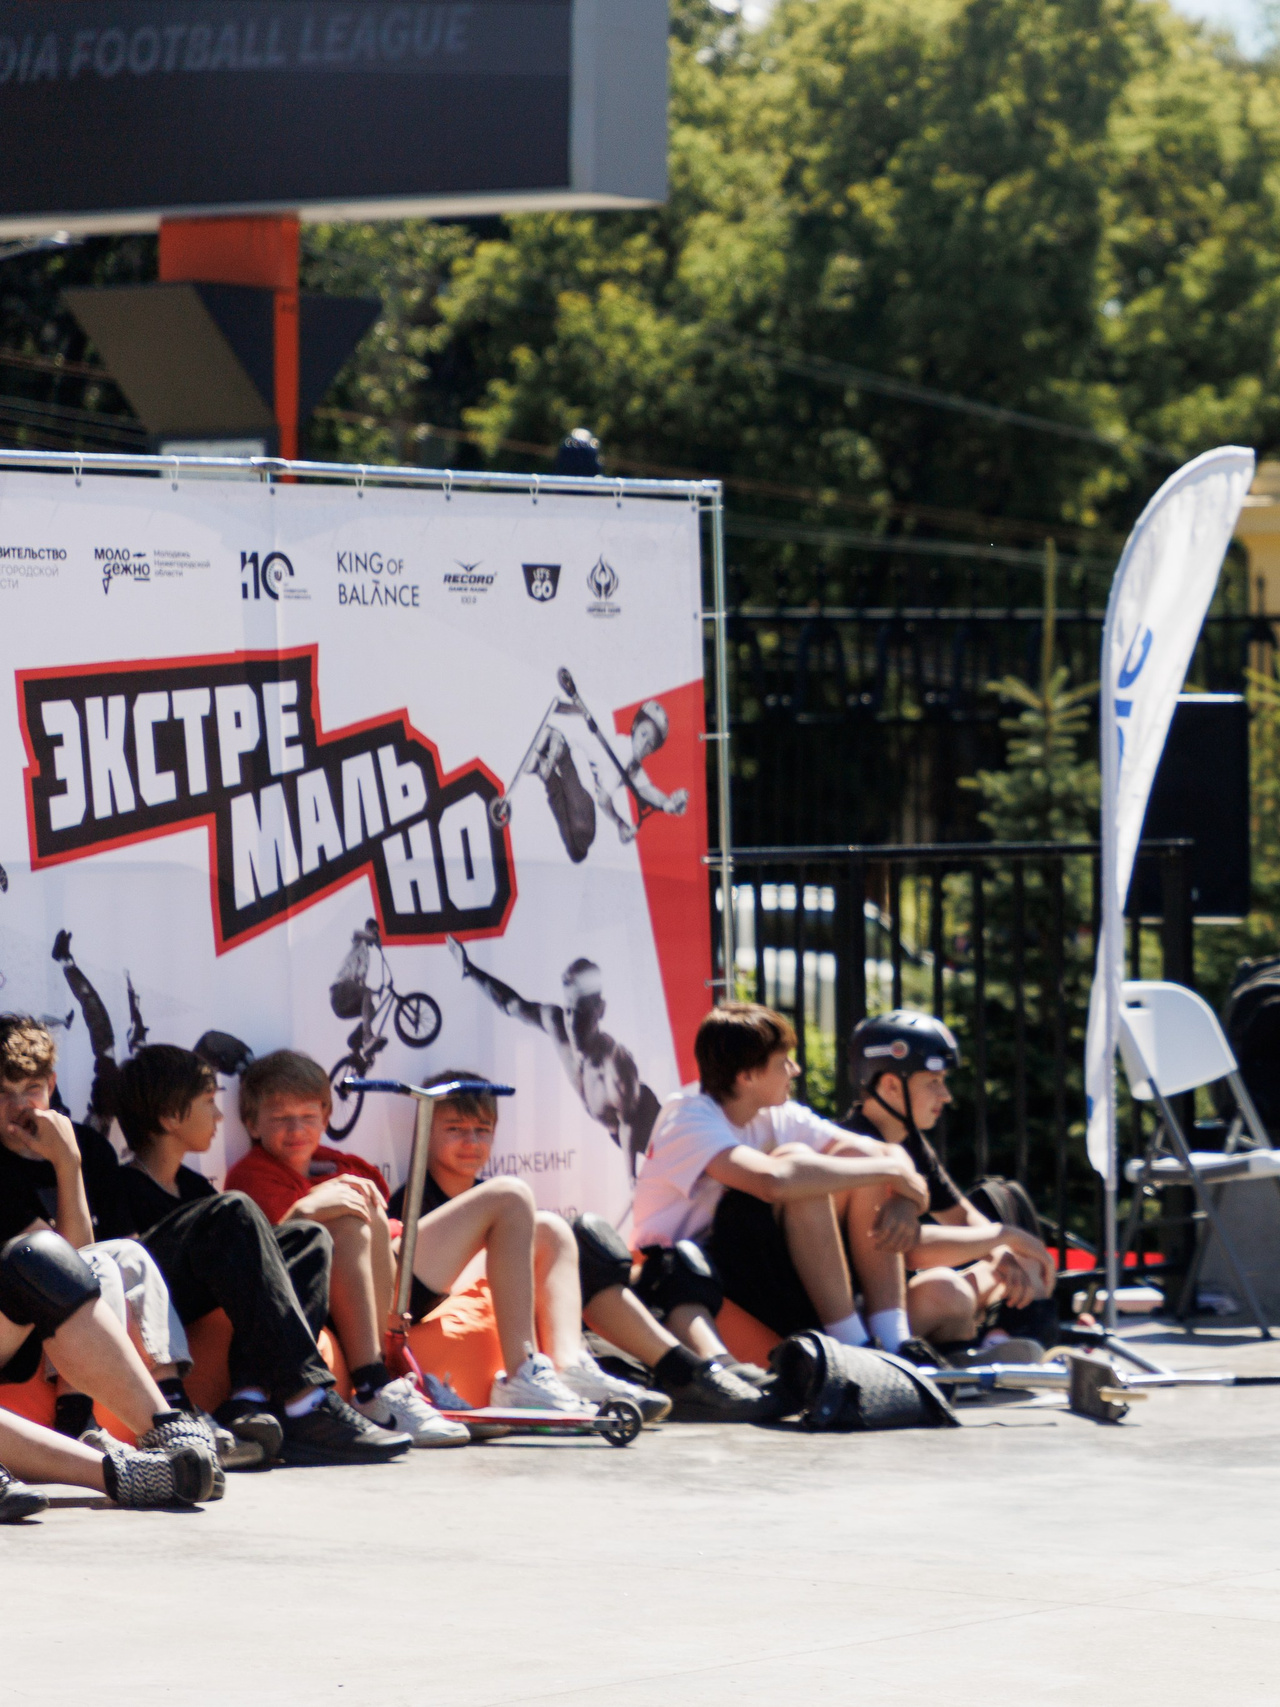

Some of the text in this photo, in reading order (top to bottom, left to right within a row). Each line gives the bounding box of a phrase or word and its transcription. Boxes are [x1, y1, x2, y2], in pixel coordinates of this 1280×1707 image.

[70, 17, 287, 79] FOOTBALL
[299, 4, 474, 63] LEAGUE
[337, 551, 404, 575] KING OF
[443, 573, 494, 585] RECORD
[531, 579, 553, 599] GO
[41, 680, 304, 832] ЭКСТРЕ
[230, 743, 429, 911] МАЛЬ
[382, 791, 498, 914] НО
